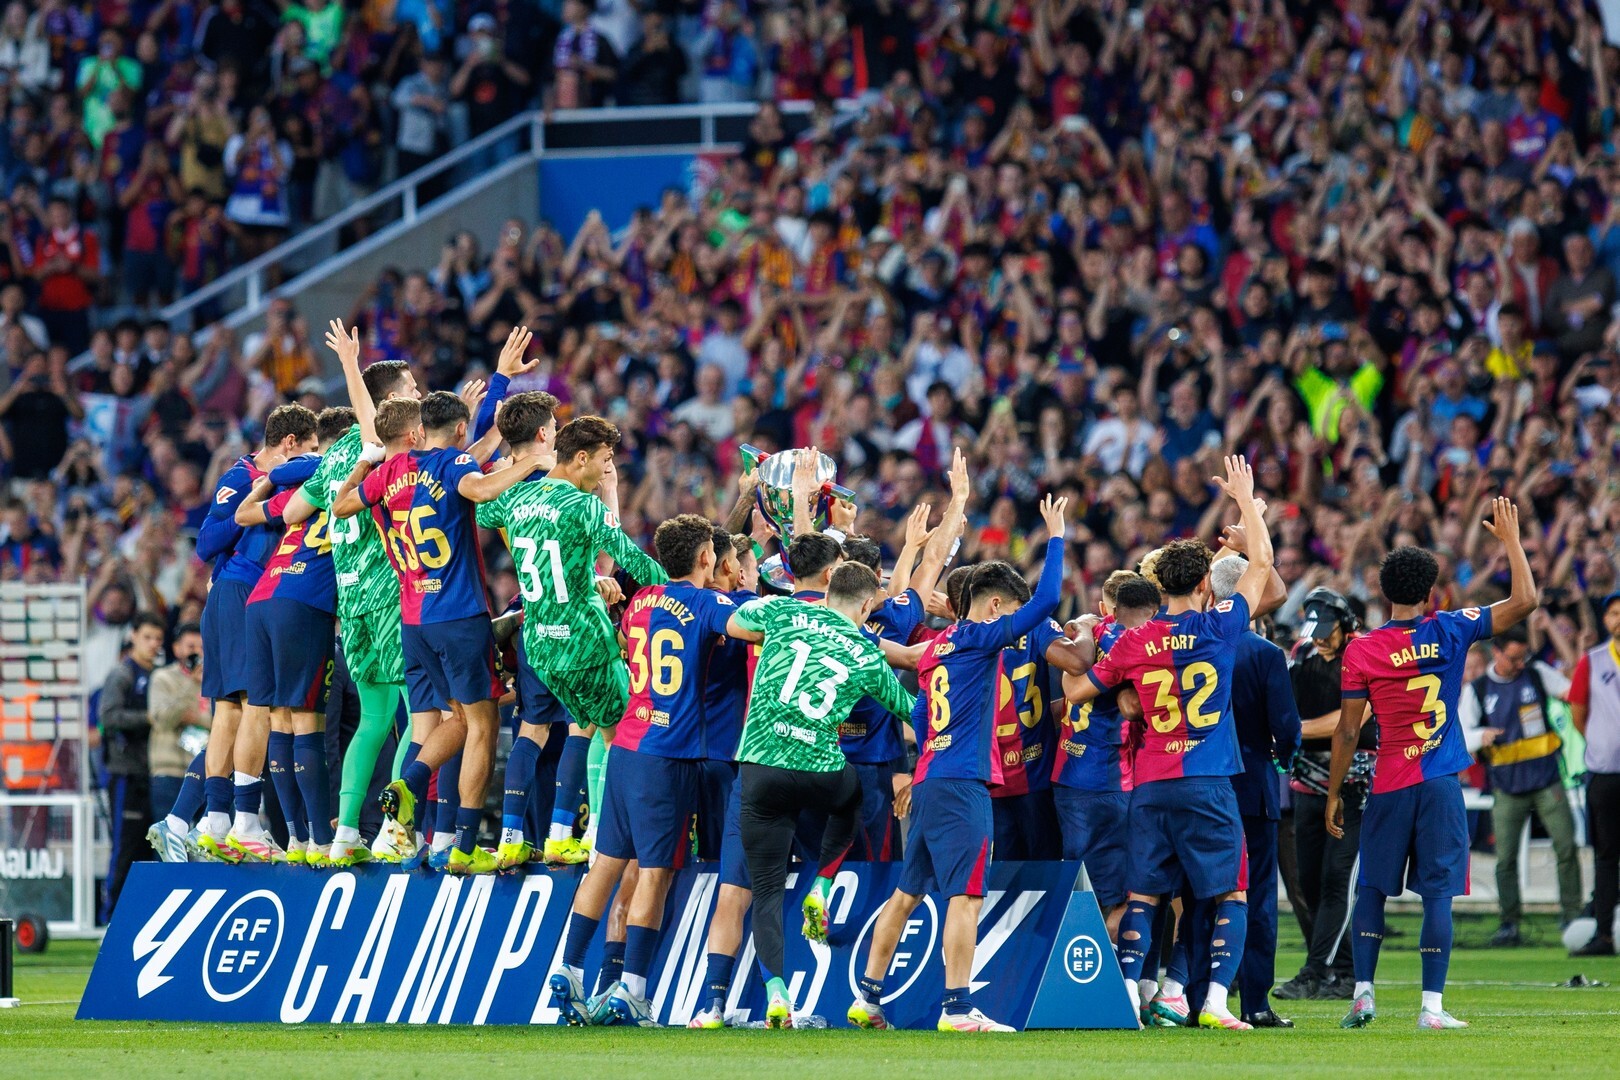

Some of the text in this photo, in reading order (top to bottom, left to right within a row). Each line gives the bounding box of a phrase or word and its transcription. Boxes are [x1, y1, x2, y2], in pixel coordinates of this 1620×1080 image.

[512, 503, 561, 524] KOCHEN
[513, 536, 570, 605] 31
[1144, 634, 1198, 657] H. FORT
[1389, 643, 1440, 668] BALDE
[628, 626, 685, 696] 36
[778, 639, 850, 720] 13
[929, 664, 951, 733] 8
[1141, 661, 1222, 734] 32
[1406, 673, 1447, 740] 3
[228, 918, 272, 941] RF
[900, 919, 924, 943] F
[280, 871, 859, 1025] CAMPNS
[1073, 947, 1094, 958] RF
[216, 950, 260, 973] EF
[888, 952, 912, 975] F
[1073, 961, 1094, 971] EF
